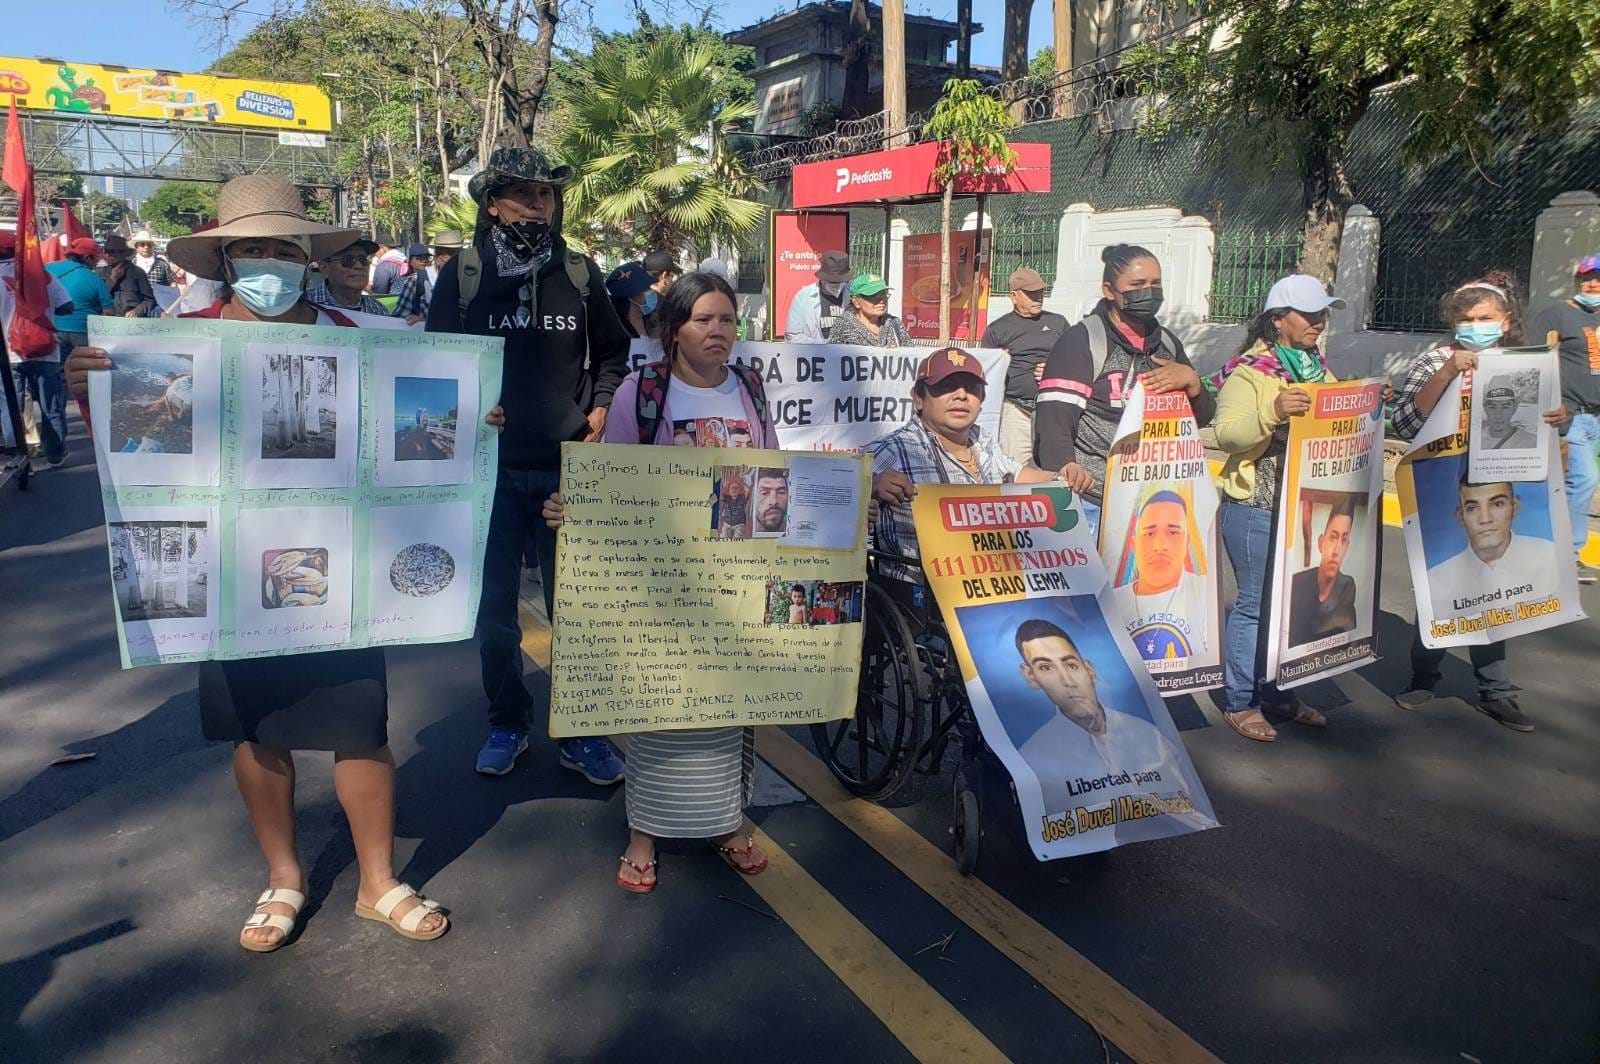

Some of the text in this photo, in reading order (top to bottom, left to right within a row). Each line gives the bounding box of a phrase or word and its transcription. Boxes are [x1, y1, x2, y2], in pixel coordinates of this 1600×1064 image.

[851, 168, 892, 185] PedidosYa
[489, 315, 577, 330] LAWESS
[796, 357, 825, 382] DE
[840, 355, 918, 382] DENUN
[768, 398, 812, 425] UCE
[1322, 391, 1374, 412] LIBERTAD
[1143, 420, 1192, 438] PARA LOS
[1332, 420, 1354, 436] PARA
[1307, 441, 1329, 461] 108
[567, 456, 639, 480] Exigimos
[669, 462, 712, 479] Libertad
[1121, 462, 1204, 482] DEL BAJO LEMPA
[1311, 453, 1369, 478] DEL BAJO LEMPA
[947, 501, 1048, 527] LIBERTAD
[604, 537, 638, 548] esposa
[971, 530, 1034, 551] PARA LOS
[615, 569, 644, 577] meses
[650, 567, 688, 578] detenido
[930, 547, 1089, 578] 111 DETENIDOS
[962, 571, 1071, 600] DEL BAJO LEMPA
[1453, 583, 1533, 610] Libertad para
[1430, 594, 1561, 638] José Duval Mata Alvarado
[567, 634, 617, 647] exigimos
[1154, 672, 1223, 688] odríguez López
[1280, 661, 1315, 680] Mauricio
[605, 697, 675, 712] REMBERTO
[682, 694, 735, 709] JIMENEZ
[744, 691, 804, 705] ALVARADO
[1066, 769, 1162, 797] Libertad para
[1042, 810, 1075, 843] José
[1075, 798, 1118, 834] Duval
